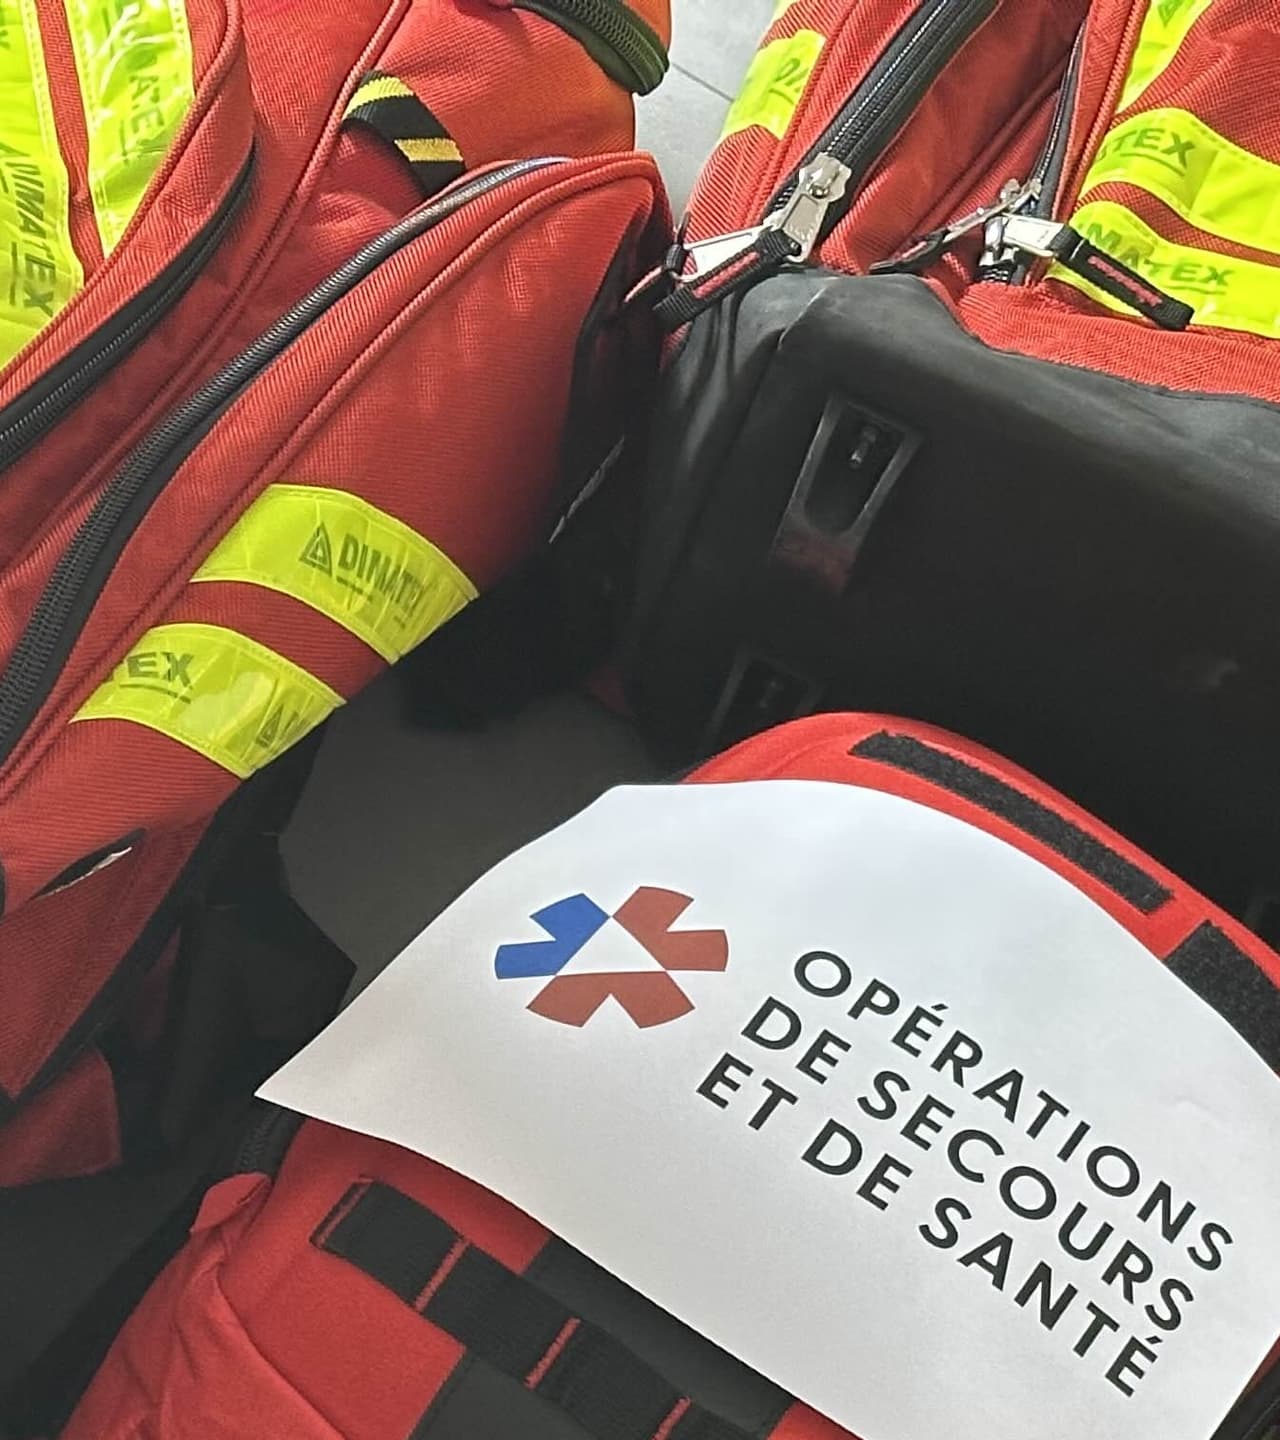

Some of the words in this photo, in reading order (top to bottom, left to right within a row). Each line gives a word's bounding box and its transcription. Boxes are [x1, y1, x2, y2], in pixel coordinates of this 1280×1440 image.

[695, 1052, 799, 1131] ET
[801, 1118, 914, 1212] DE
[918, 1197, 1163, 1398] SANTÉ
[740, 996, 852, 1085] DE
[857, 1070, 1194, 1332] SECOURS
[794, 951, 1234, 1271] OPÉRATIONS
